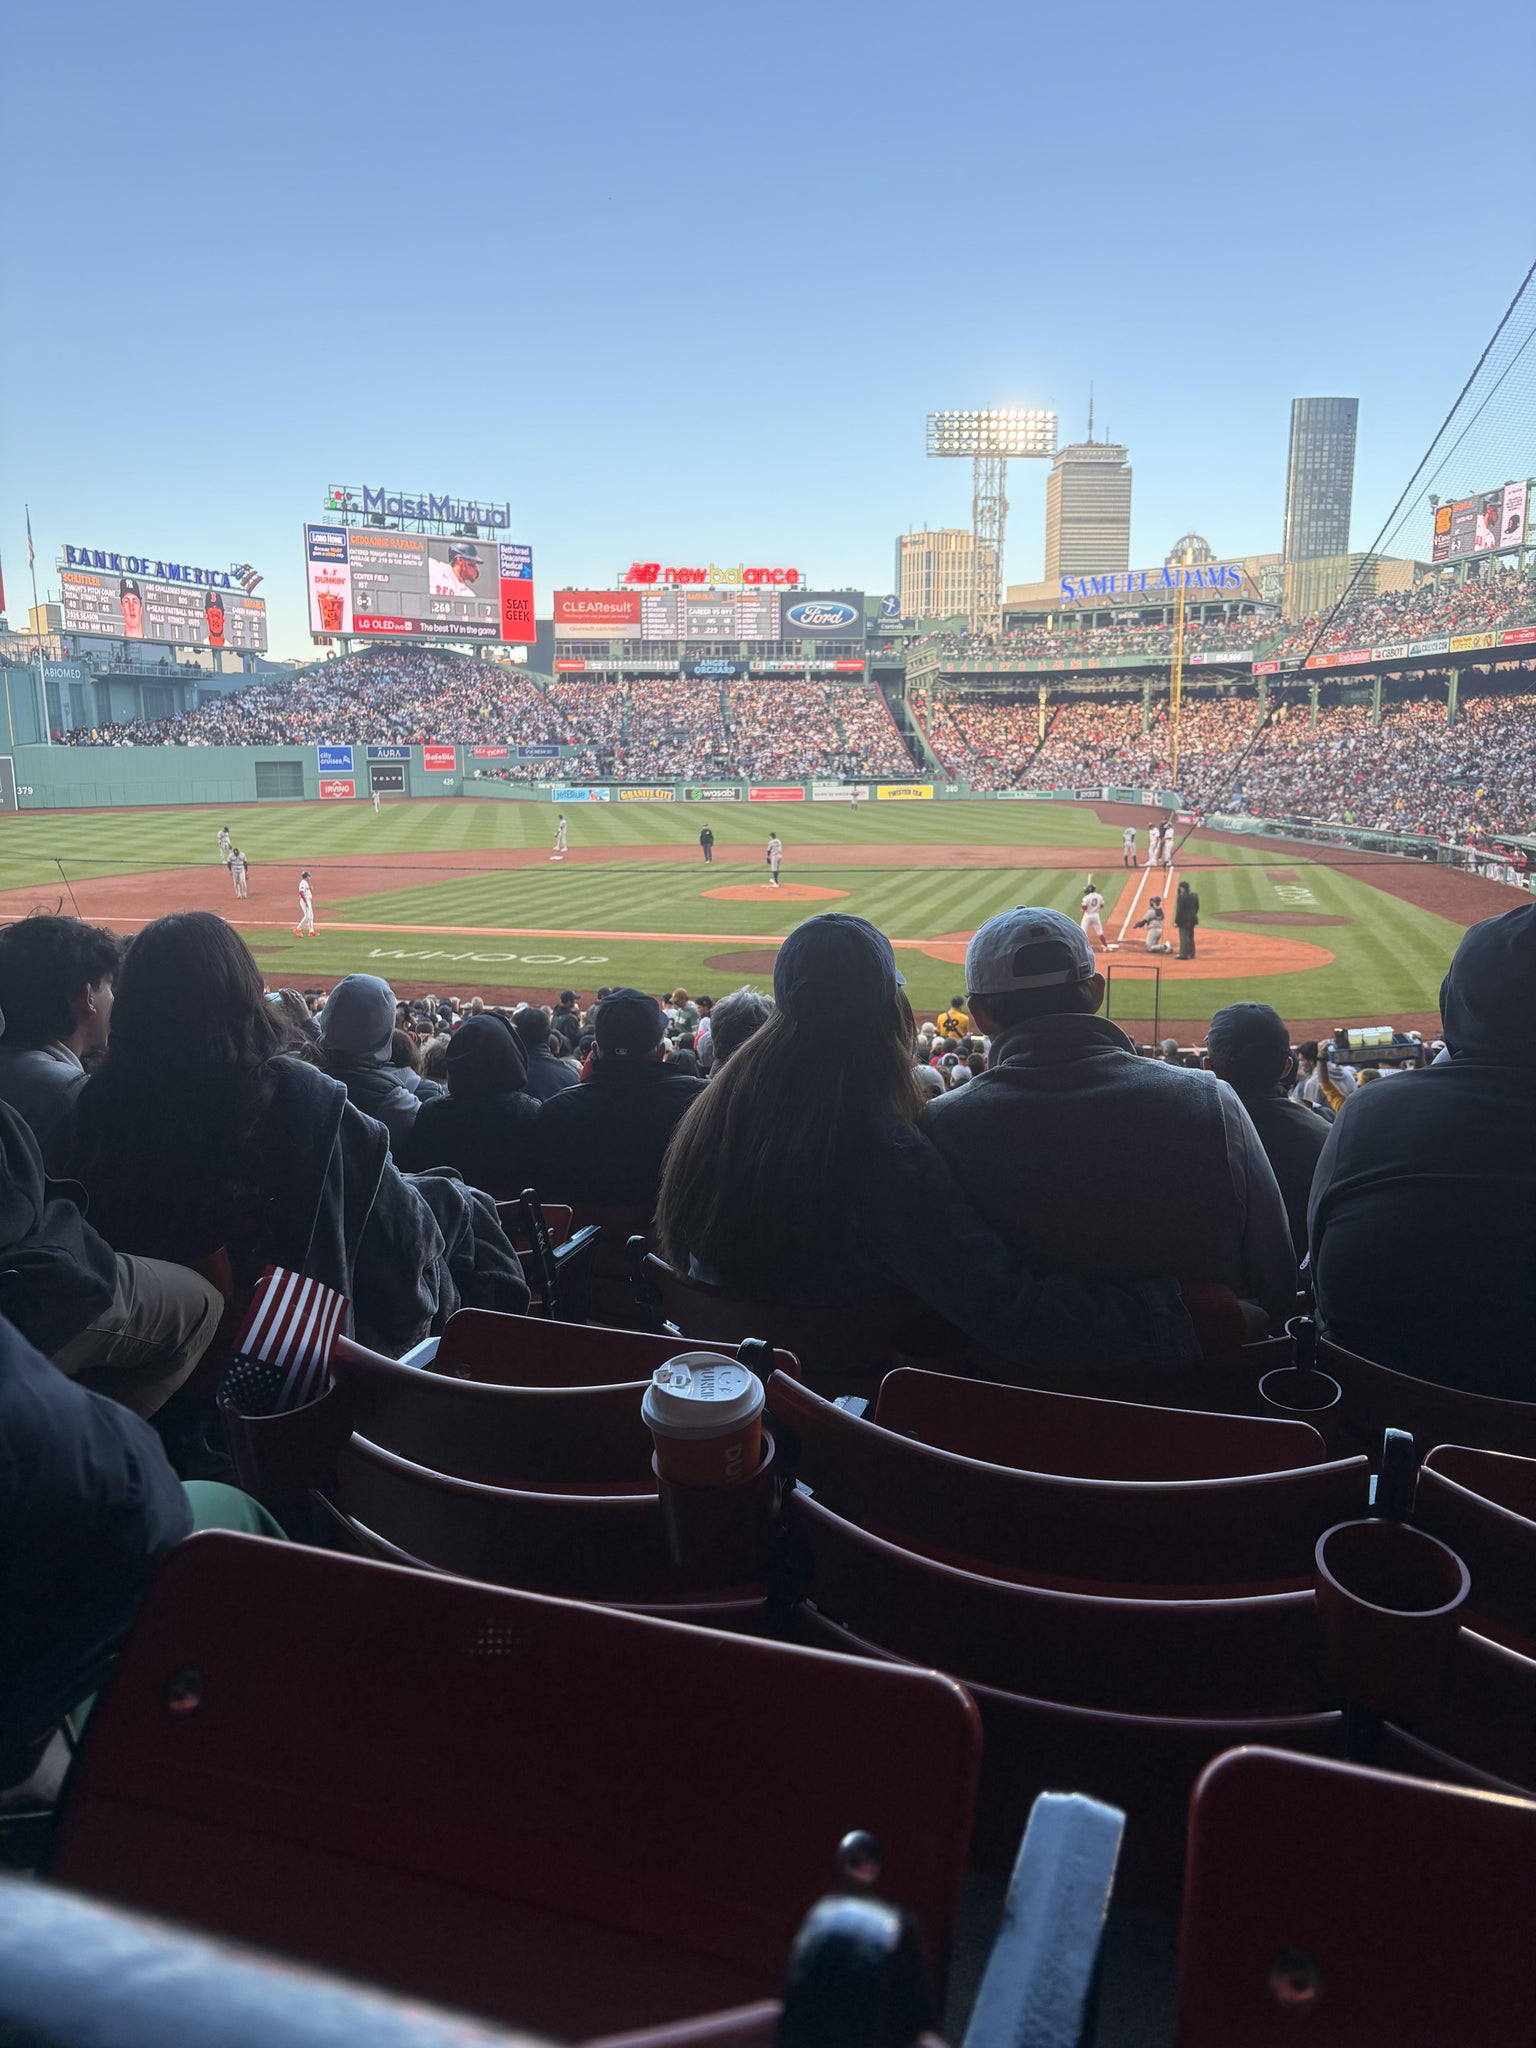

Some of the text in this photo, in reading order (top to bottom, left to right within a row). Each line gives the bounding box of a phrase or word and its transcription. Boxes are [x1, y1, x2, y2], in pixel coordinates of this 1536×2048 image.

[362, 485, 510, 528] MassMutual
[390, 539, 424, 550] RAFAELA
[501, 546, 529, 555] Beth Israel
[501, 554, 531, 563] Deaconess
[62, 544, 231, 588] BANK OF AMERICA
[501, 561, 523, 570] Medical
[374, 574, 389, 582] FIELD
[502, 569, 521, 577] Center
[63, 572, 99, 587] SCHLITTLER
[315, 576, 346, 585] DUNKIN'
[1060, 571, 1151, 603] SAMUEL
[1154, 564, 1242, 591] ADAMS
[64, 583, 116, 596] TONIGHT'S PITCH COUNT
[155, 584, 180, 594] CHALLENGES
[180, 588, 201, 598] REMAINING
[80, 593, 97, 601] STRIKES
[357, 596, 372, 606] 6-3
[686, 593, 714, 601] RAFAELA
[432, 602, 450, 613] .268
[506, 598, 529, 610] SEAT
[562, 601, 632, 612] CLEAResult
[80, 612, 99, 621] SEASON
[165, 607, 187, 616] FASTBALL
[505, 610, 530, 622] GEEK
[800, 605, 843, 624] Ford
[150, 614, 200, 627] BALLS STRIKES OUTS
[359, 620, 371, 629] LG
[372, 620, 395, 630] OLED
[420, 623, 433, 631] The
[434, 624, 449, 633] best
[450, 625, 459, 633] TV
[459, 625, 466, 633] in
[466, 626, 478, 634] the
[478, 627, 497, 636] game
[45, 667, 81, 679] ABIOMED
[694, 666, 735, 674] ORCHARD
[320, 752, 332, 760] city
[425, 753, 455, 761] Safelite
[16, 787, 34, 795] 379
[325, 785, 350, 793] IRVING
[557, 789, 586, 799] jetBlue
[703, 789, 735, 798] wasabi
[911, 789, 923, 797] TEA
[621, 789, 673, 800] GRANITE CITY
[368, 948, 609, 965] WHOOP
